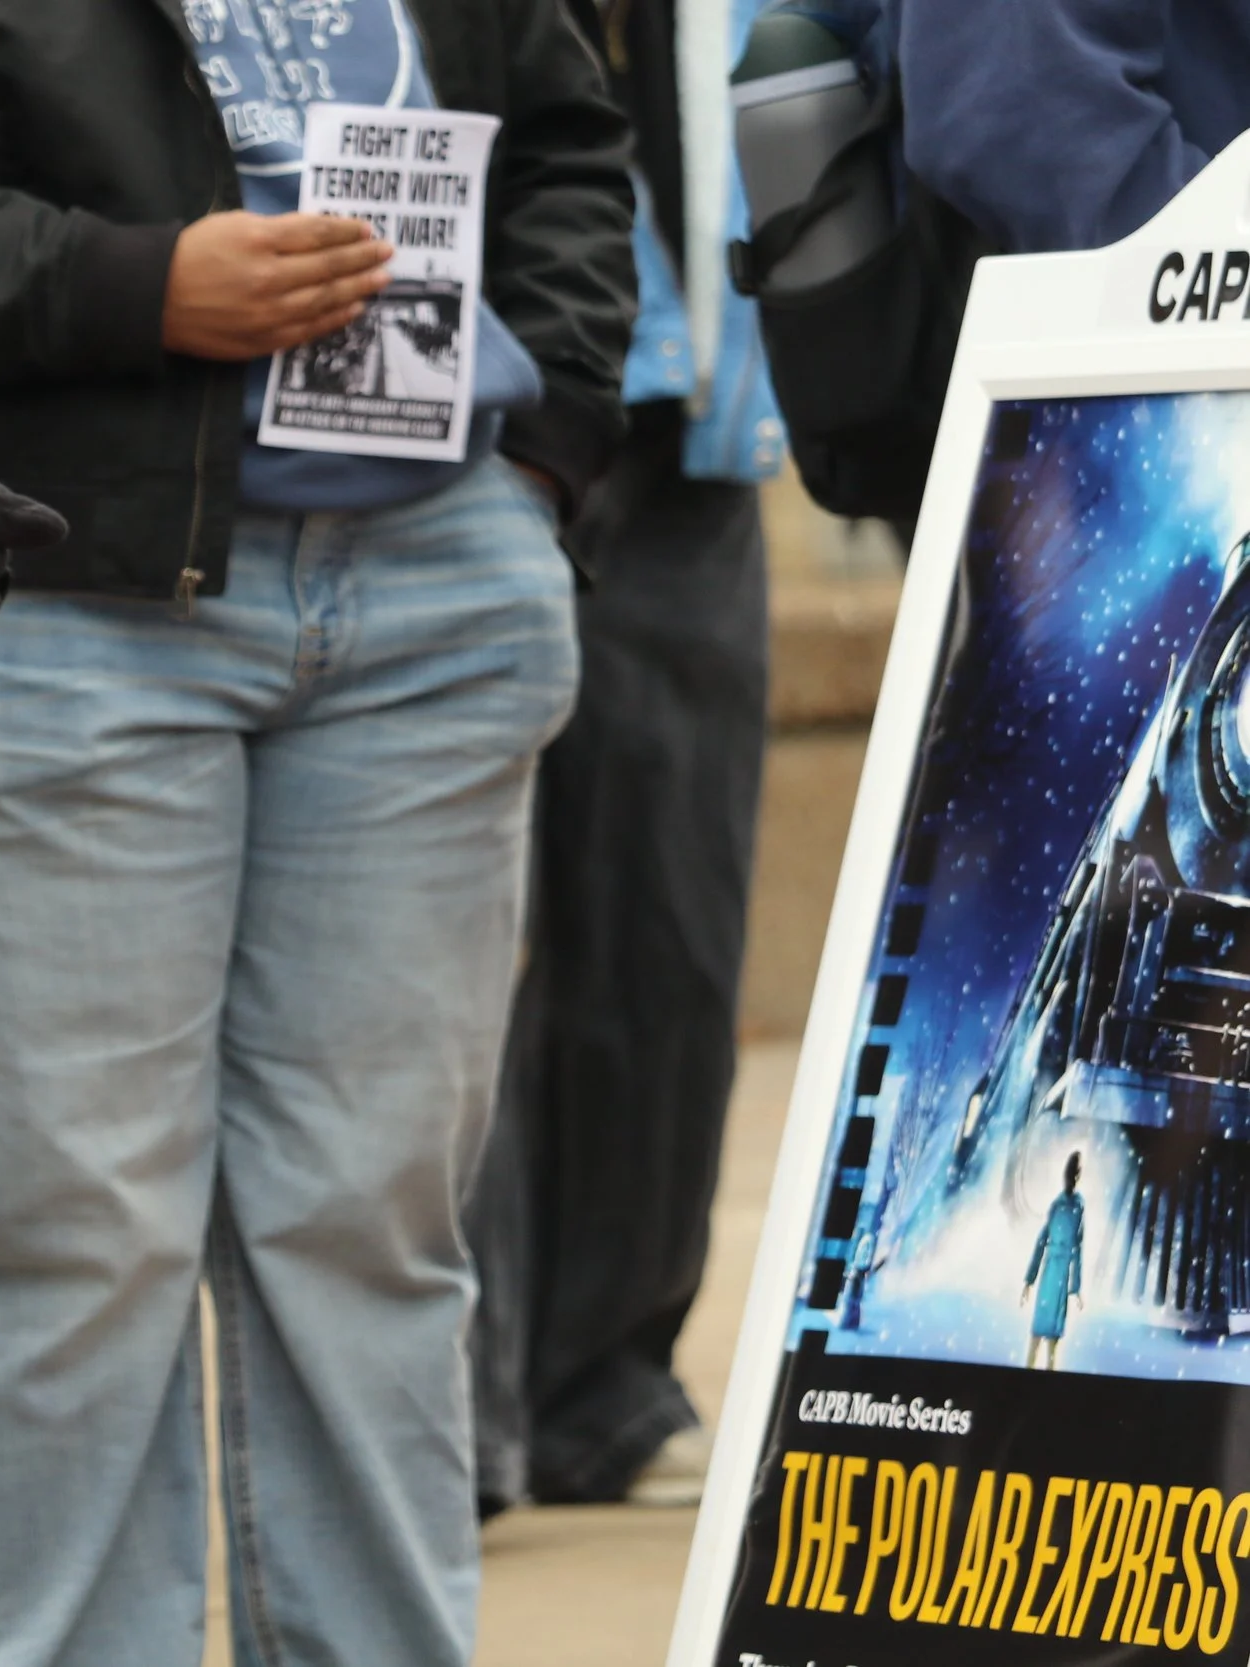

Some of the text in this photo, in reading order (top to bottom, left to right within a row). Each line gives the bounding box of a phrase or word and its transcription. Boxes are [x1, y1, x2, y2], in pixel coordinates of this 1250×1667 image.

[340, 123, 409, 159] FIGHT
[414, 127, 453, 162] ICE
[311, 165, 469, 207] TERROR WITH
[395, 214, 457, 250] WAR!
[1147, 250, 1250, 324] CAP
[798, 1388, 971, 1435] CAPB Movie Series
[765, 1450, 1250, 1656] THE POLAR EXPRESS
